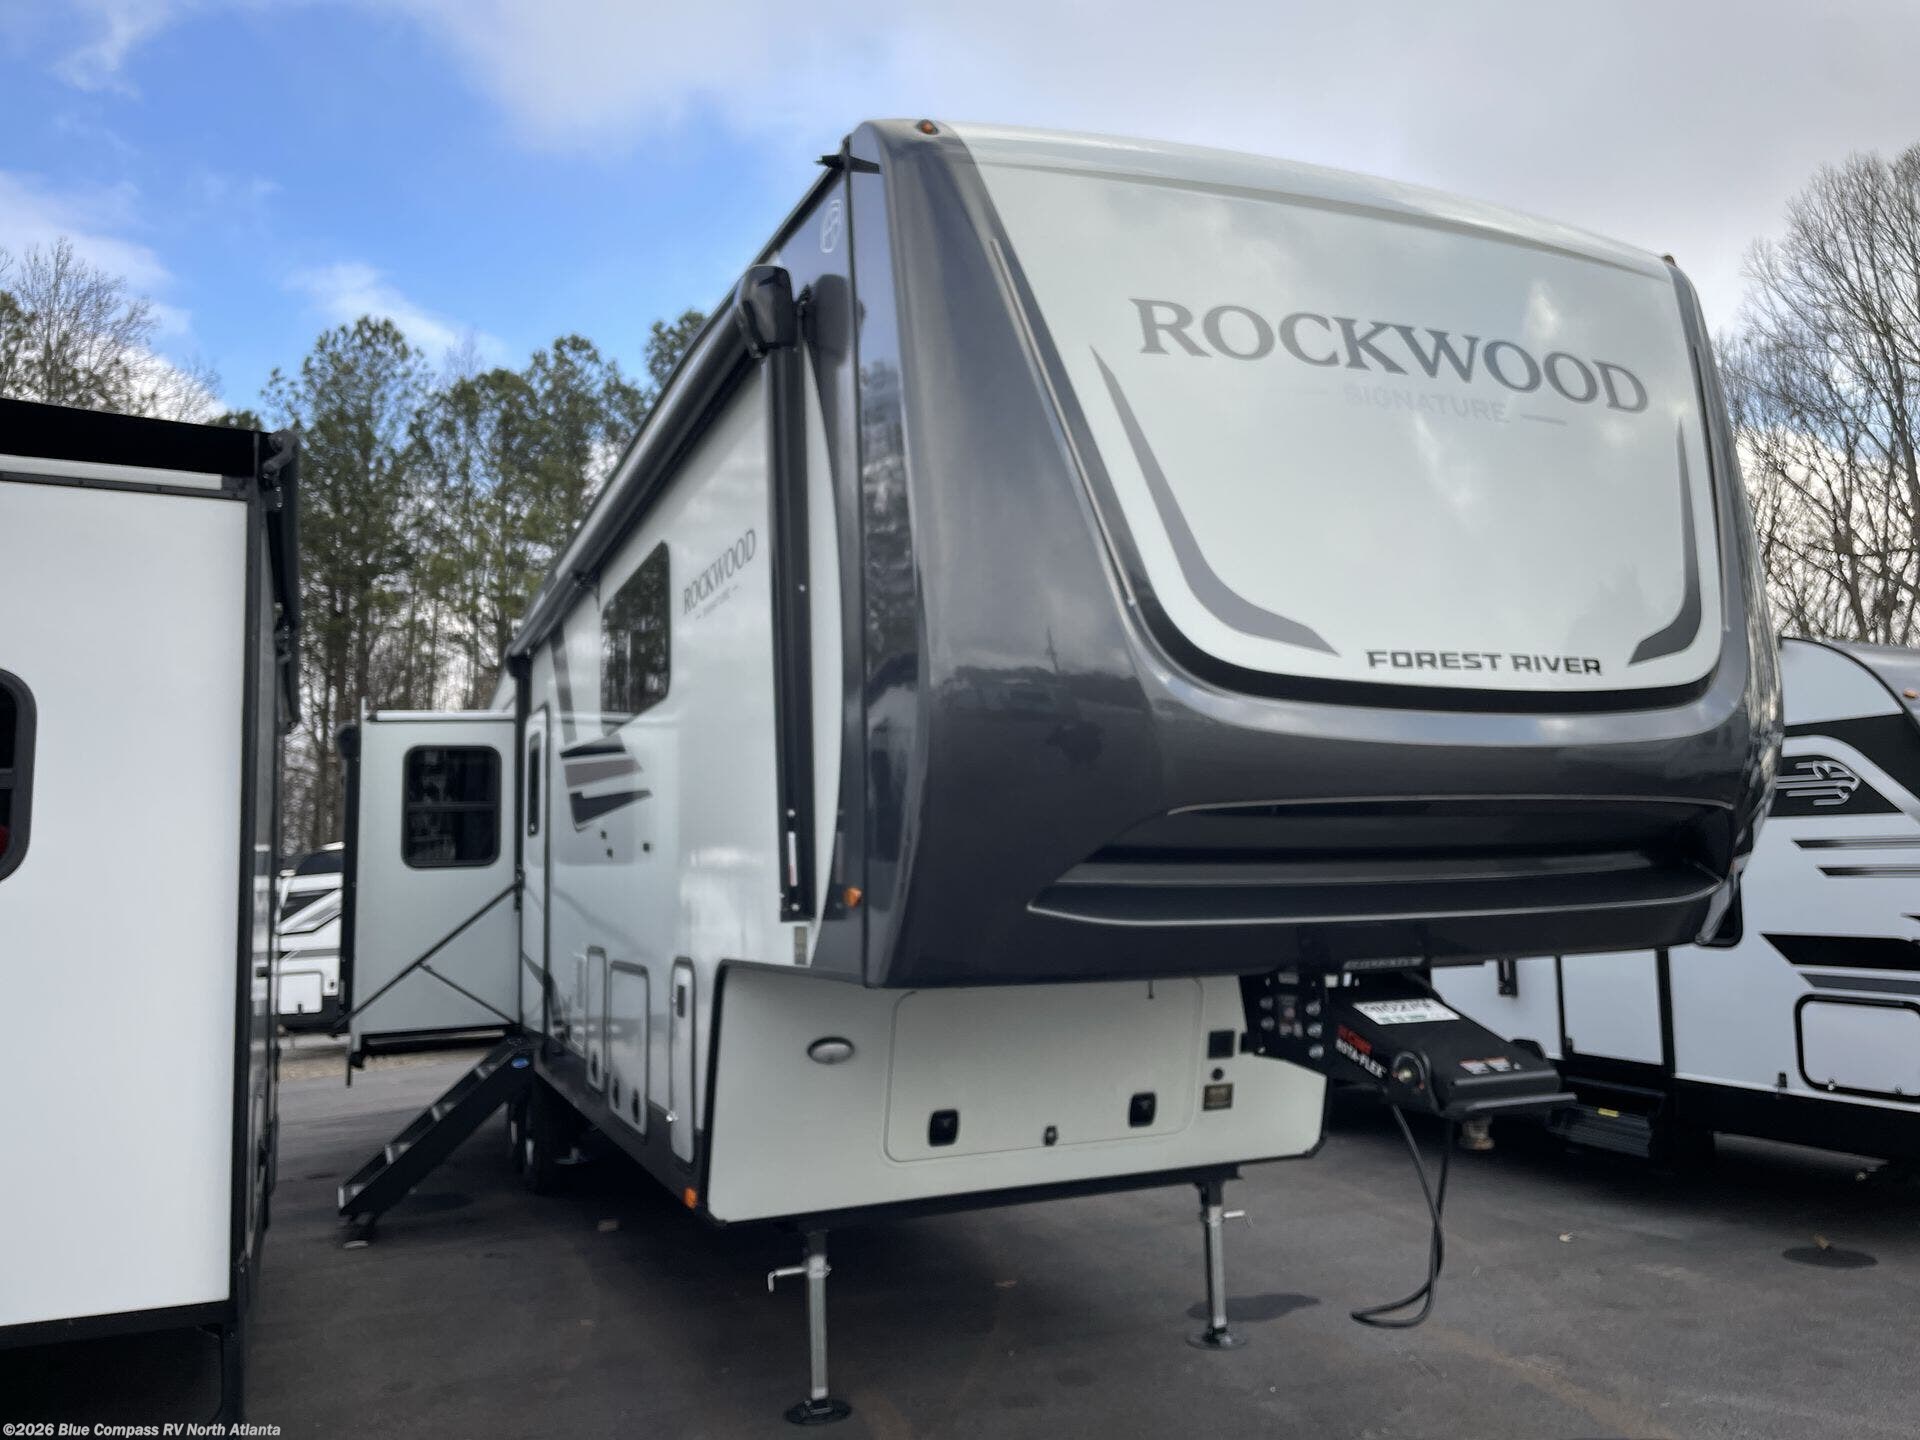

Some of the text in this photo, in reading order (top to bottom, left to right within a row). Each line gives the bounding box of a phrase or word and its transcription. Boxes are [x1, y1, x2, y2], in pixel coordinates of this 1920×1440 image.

[1130, 298, 1649, 414] ROCKWOOD
[1344, 384, 1510, 424] SIGNATURE
[683, 529, 756, 615] ROCKWOOD
[1366, 650, 1603, 676] FOREST RIVER
